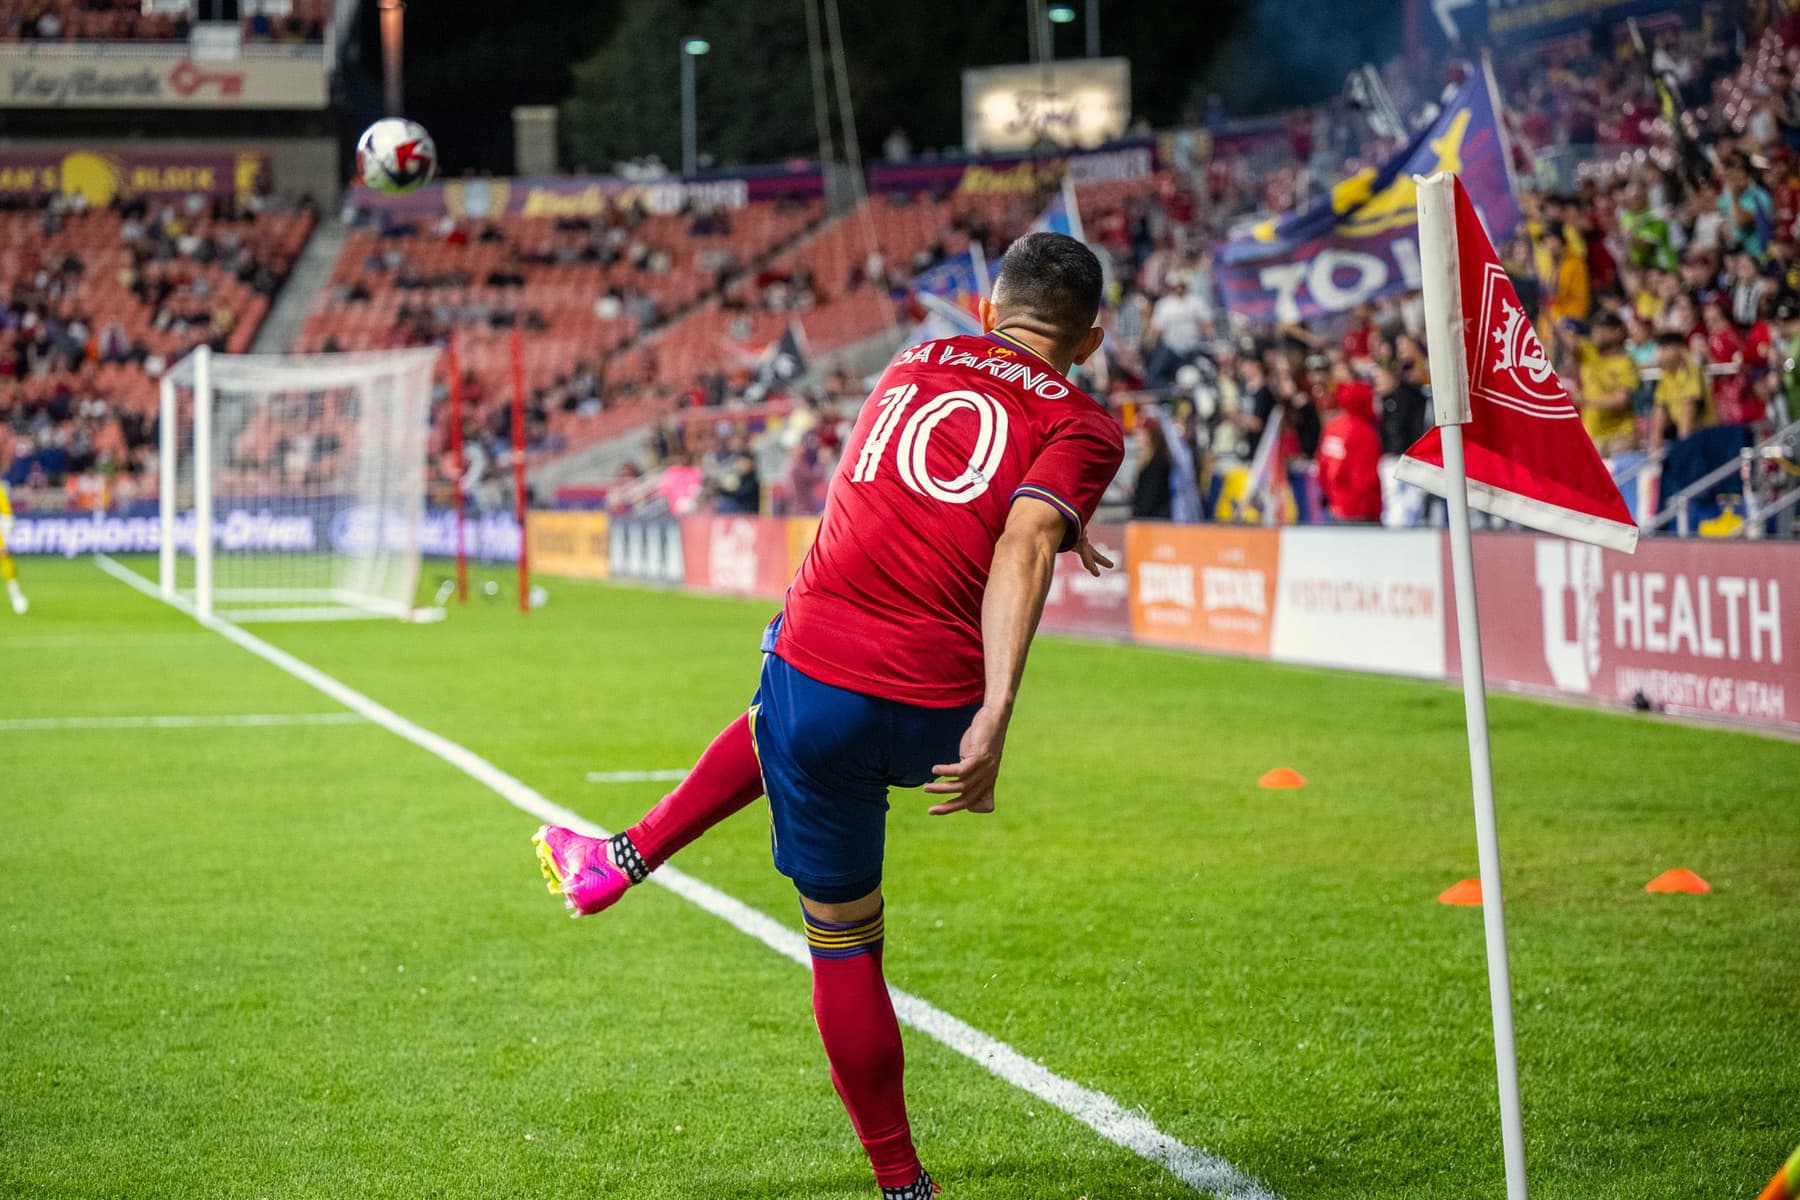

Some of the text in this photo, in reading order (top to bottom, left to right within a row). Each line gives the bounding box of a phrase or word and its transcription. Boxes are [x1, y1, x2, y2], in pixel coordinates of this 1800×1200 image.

[851, 383, 1009, 503] 10
[1611, 570, 1783, 665] HEALTH
[1615, 666, 1786, 720] UNIVERSITY OF UTAH
